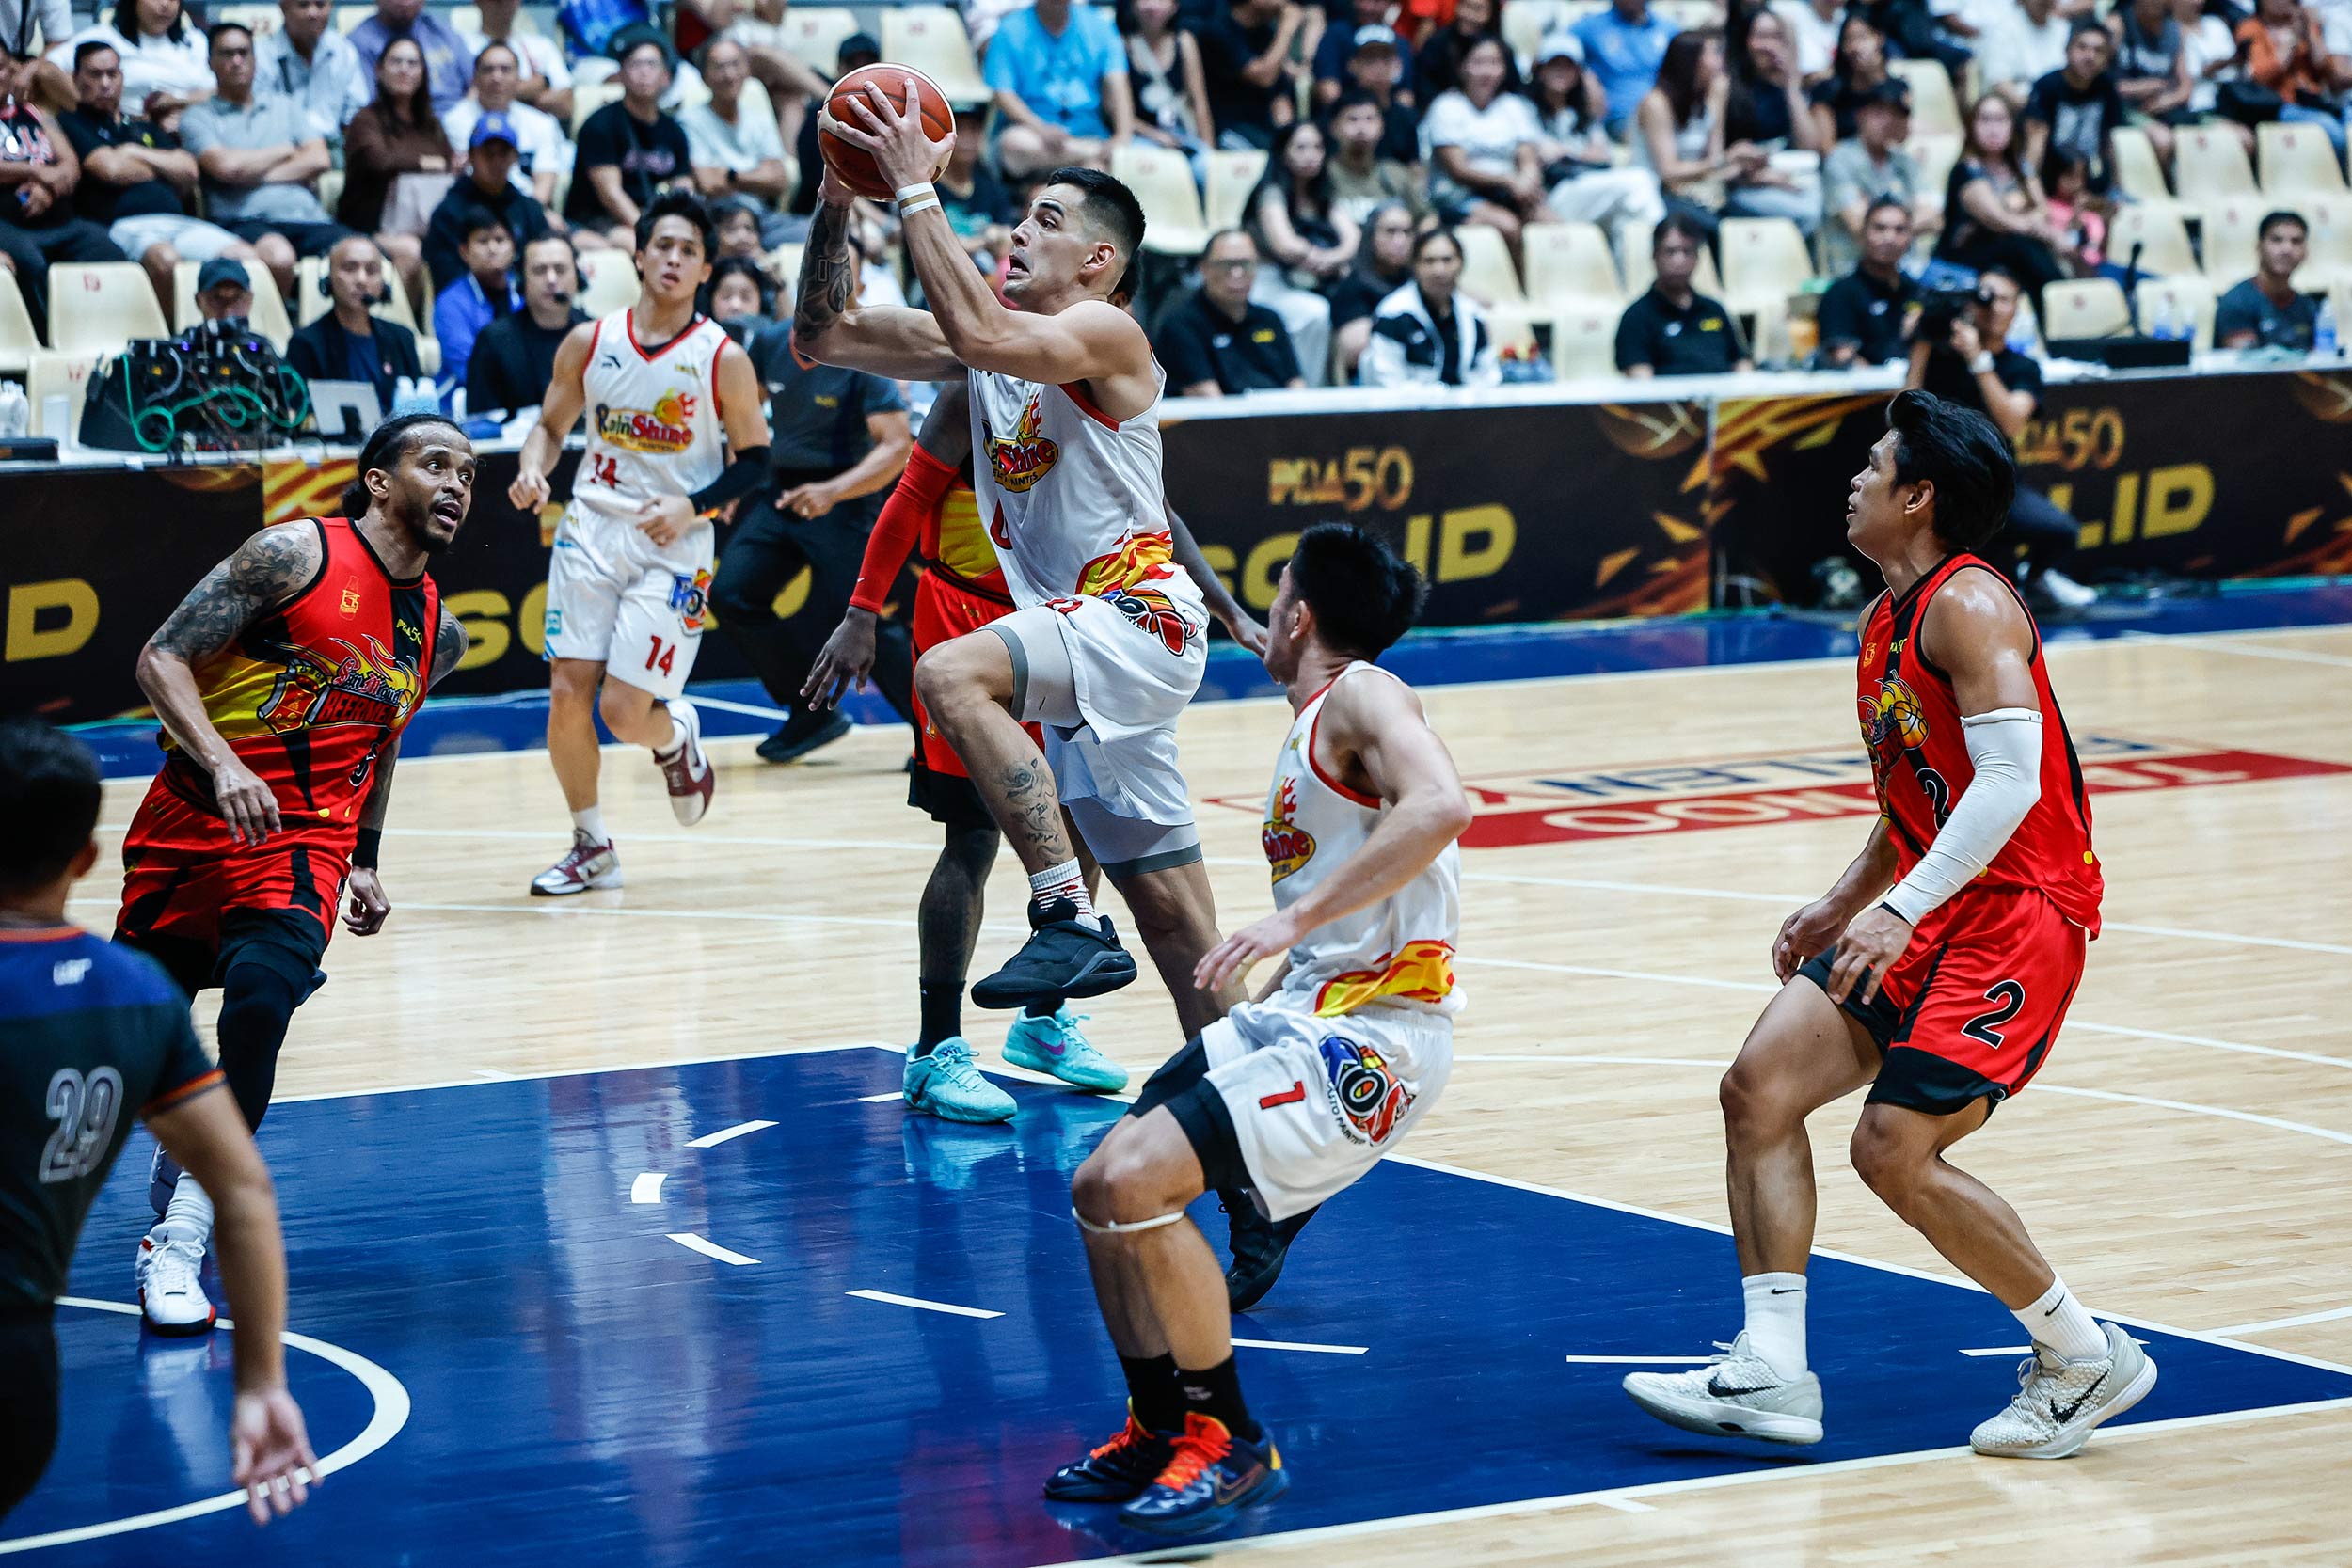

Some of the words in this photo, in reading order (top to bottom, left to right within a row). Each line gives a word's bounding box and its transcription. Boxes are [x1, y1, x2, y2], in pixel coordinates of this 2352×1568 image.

[645, 634, 676, 679] 14
[1960, 978, 2026, 1050] 2
[1259, 1081, 1306, 1110] 1
